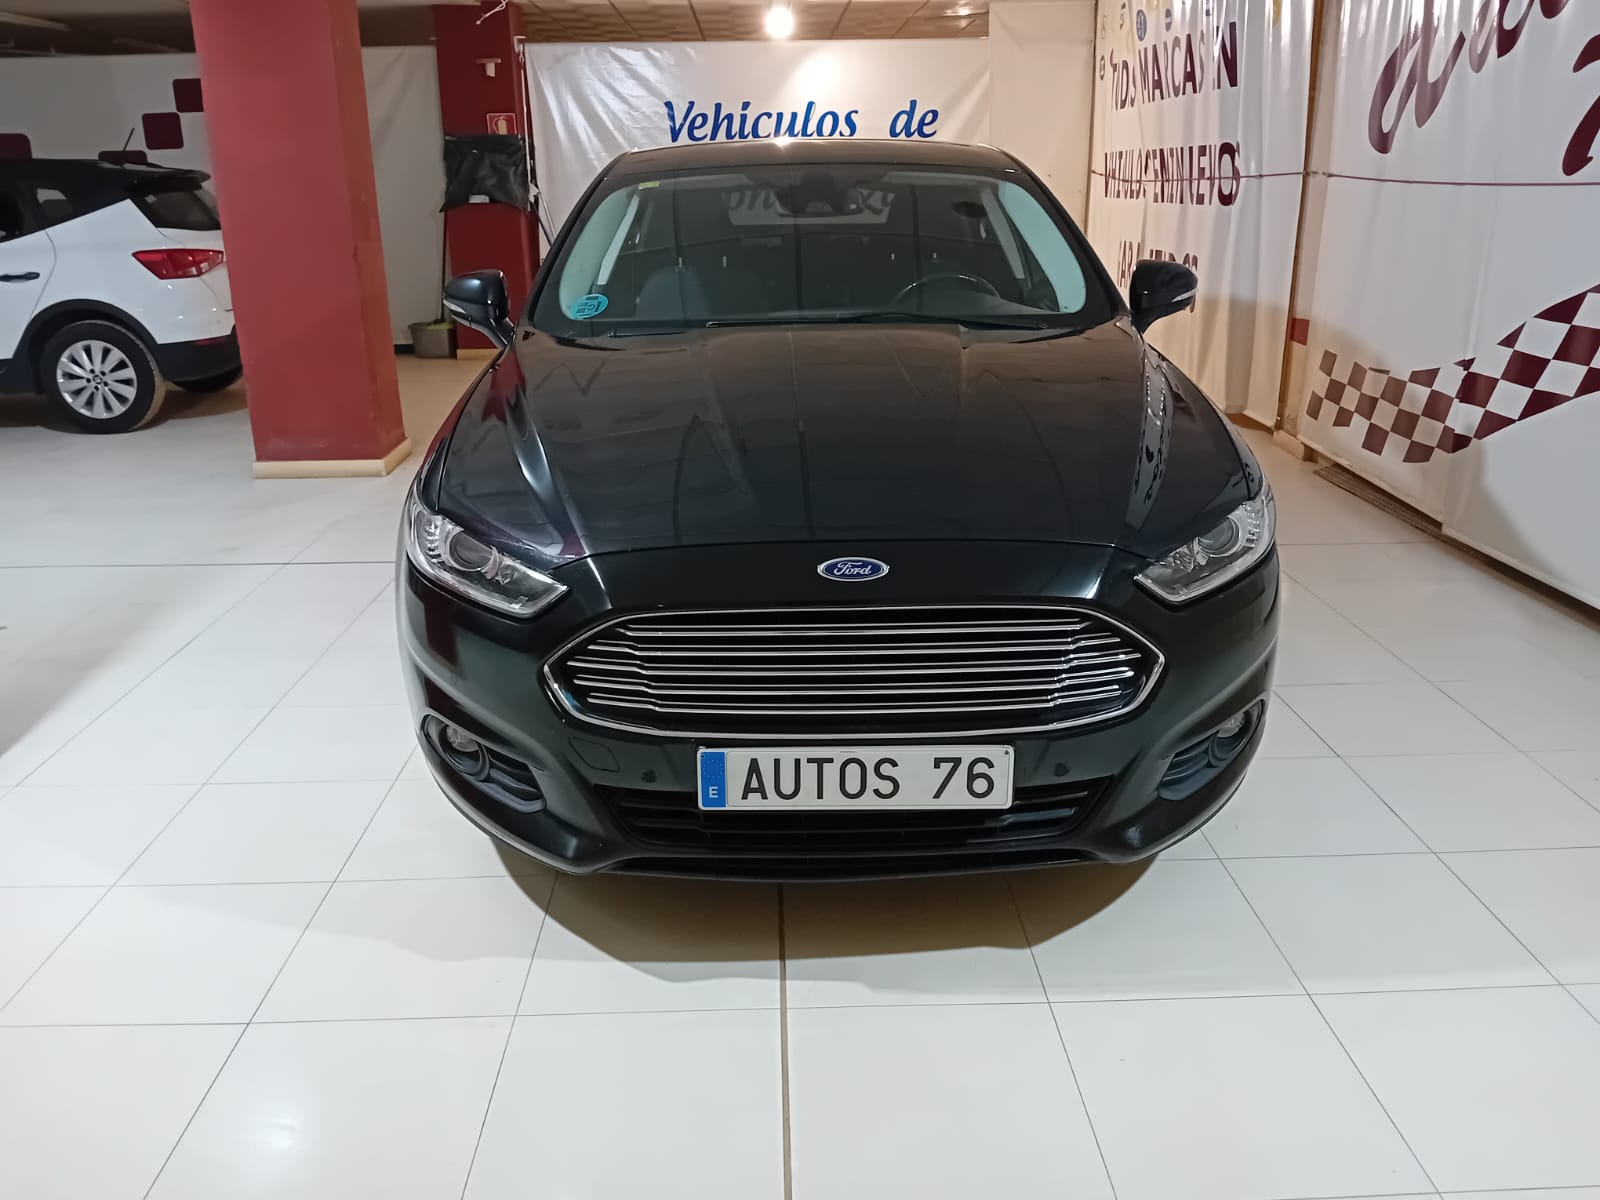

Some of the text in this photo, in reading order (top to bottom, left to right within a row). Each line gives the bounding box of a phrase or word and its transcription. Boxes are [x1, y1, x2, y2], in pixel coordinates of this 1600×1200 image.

[889, 99, 939, 138] de
[833, 561, 872, 575] Ford
[741, 756, 996, 801] AUTOS 76
[708, 786, 719, 799] E
